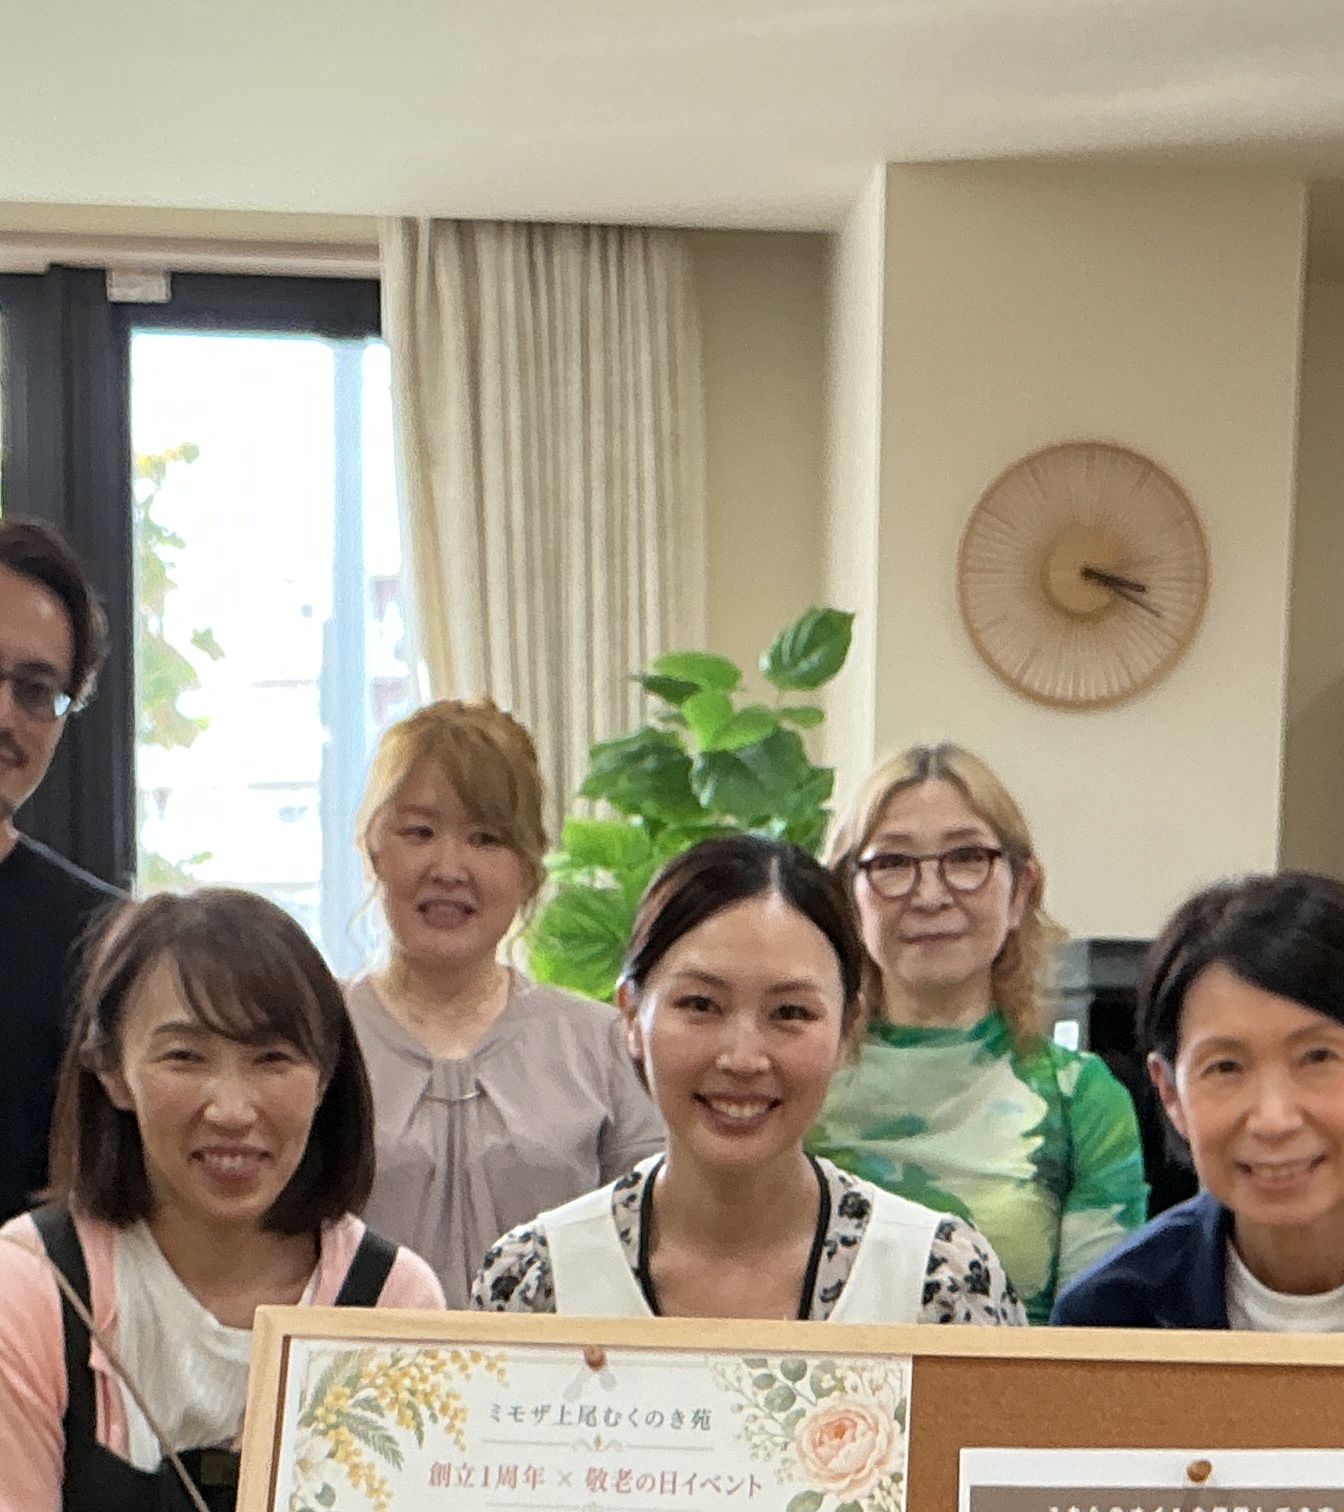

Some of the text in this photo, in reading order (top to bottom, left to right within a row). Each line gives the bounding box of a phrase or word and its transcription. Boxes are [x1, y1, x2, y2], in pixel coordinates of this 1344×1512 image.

[489, 1403, 712, 1431] ミモザ上尾むくのき苑
[427, 1461, 545, 1490] 創立1周年
[585, 1467, 762, 1498] 敬老の日イベント
